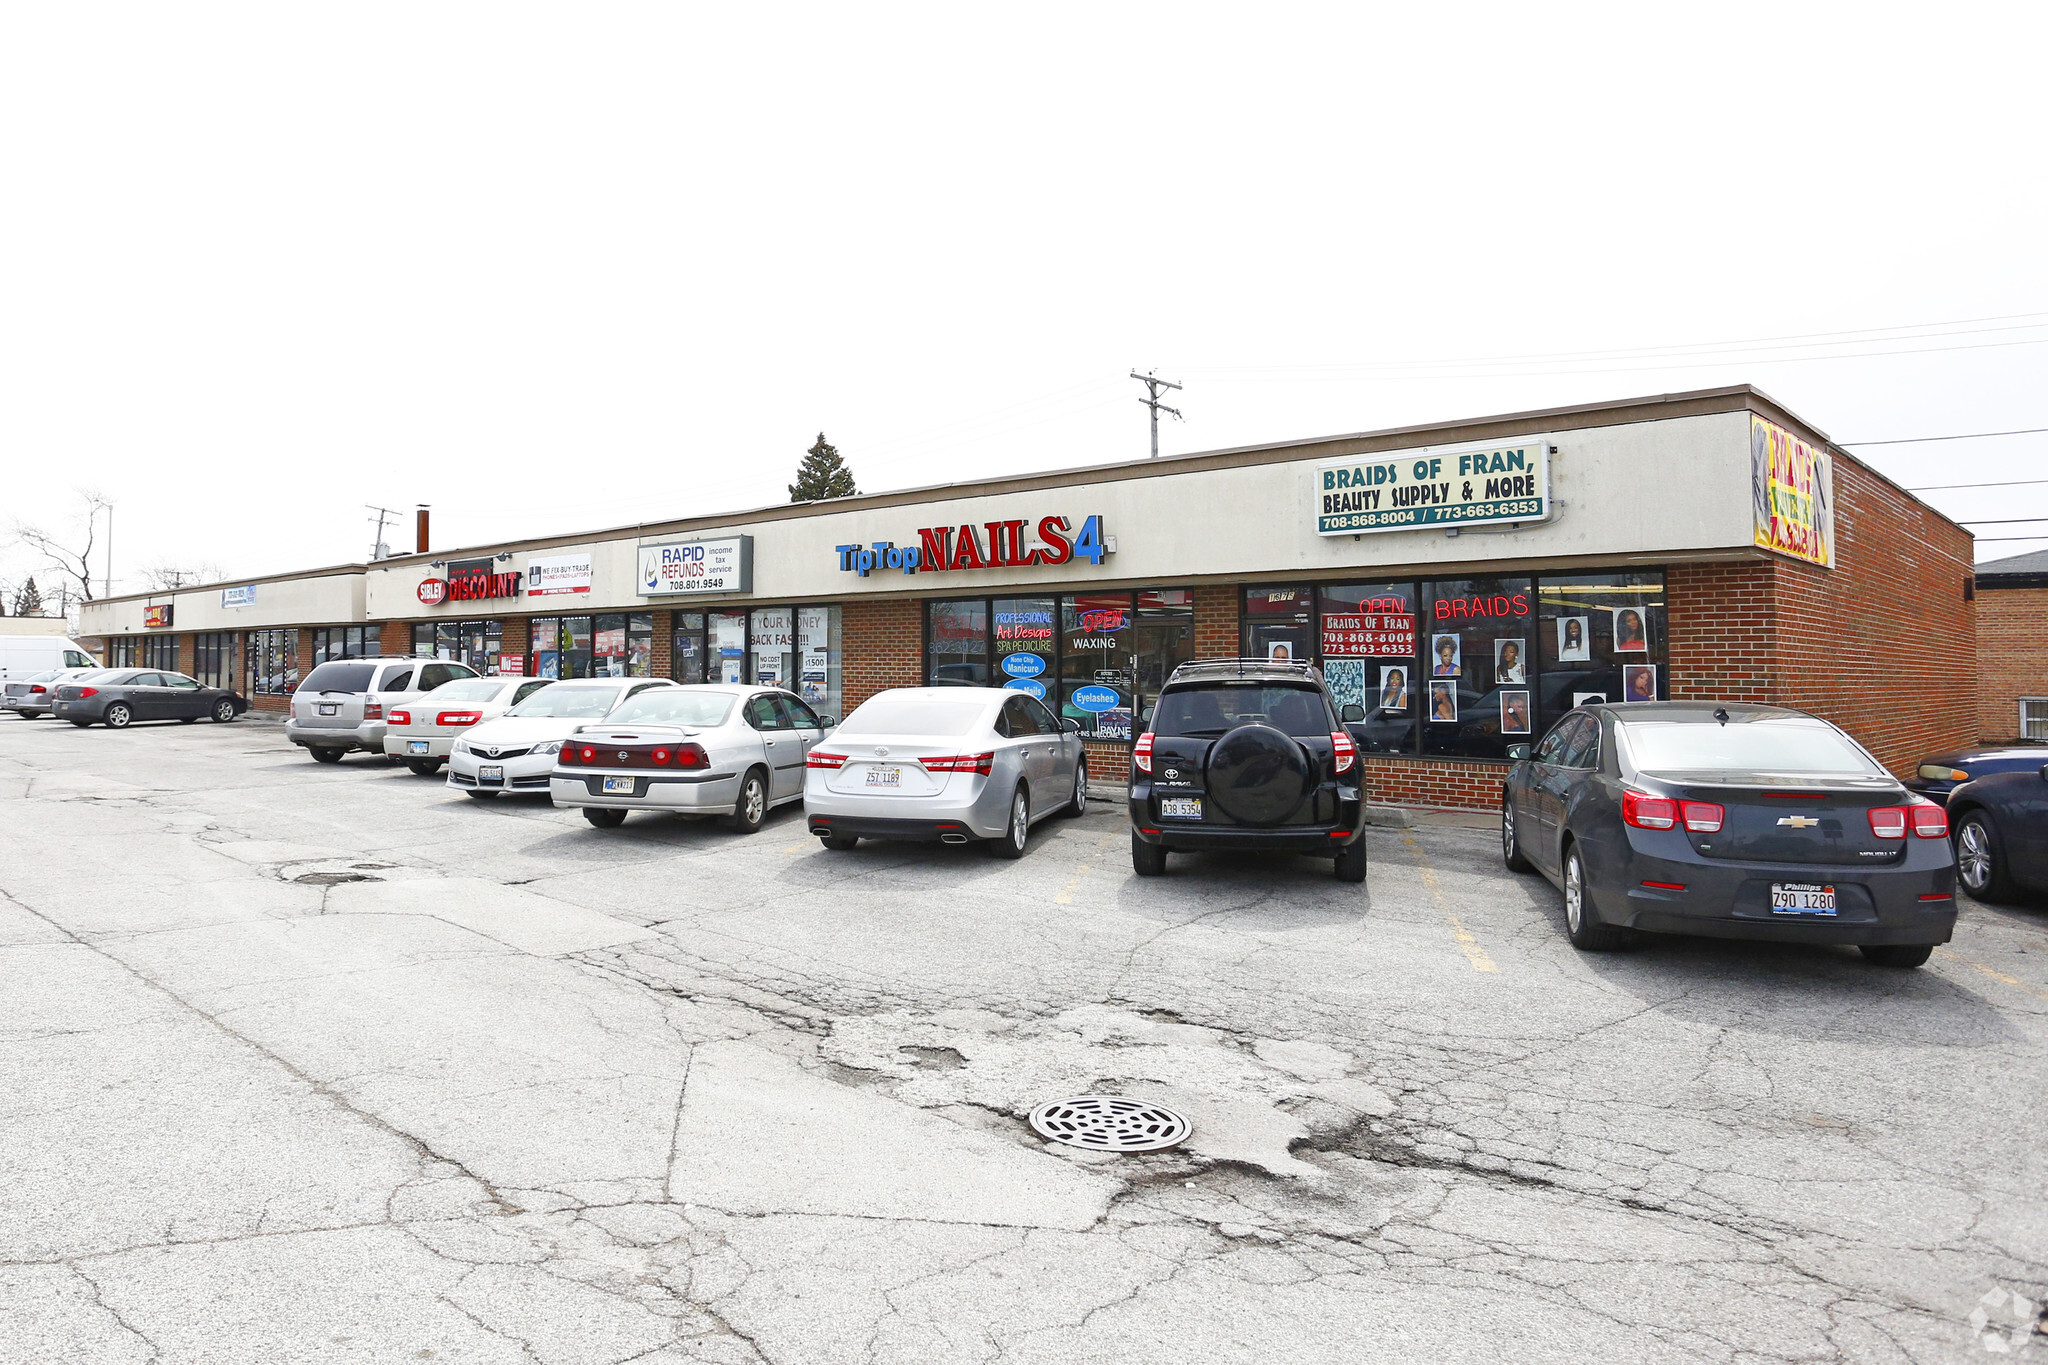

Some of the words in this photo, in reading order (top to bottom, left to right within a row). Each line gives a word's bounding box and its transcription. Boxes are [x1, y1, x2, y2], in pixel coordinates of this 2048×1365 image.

[1323, 463, 1397, 490] BRAIDS
[1413, 459, 1442, 480] OF
[1459, 450, 1534, 476] FRAN,
[1323, 490, 1380, 514] BEAUTY
[1392, 482, 1450, 507] SUPPLY
[1462, 480, 1473, 501] &
[1485, 474, 1535, 500] MORE
[1322, 510, 1416, 529] 708-868-8004
[1422, 509, 1428, 522] /
[1434, 500, 1538, 520] 773-663-6353
[708, 546, 732, 554] income
[918, 516, 1072, 572] NAILS
[1074, 515, 1108, 565] 4
[662, 546, 704, 564] RAPID
[662, 562, 704, 579] REFUNDS
[708, 566, 732, 574] service
[449, 572, 517, 601] DISCOUNT
[670, 578, 724, 590] 708.801.9549
[420, 582, 442, 600] SIBLEY
[1359, 598, 1404, 614] OPEN
[1434, 594, 1529, 620] BRAIDS
[758, 617, 784, 628] YOUR
[995, 612, 1052, 624] PROFESSIONAL
[1082, 609, 1123, 632] OPEN
[996, 624, 1013, 640] Art
[1014, 624, 1052, 640] Designs
[1323, 632, 1413, 644] 708-868-8004
[996, 640, 1011, 652] SPA
[1012, 640, 1052, 652] PEDICURE
[1073, 638, 1116, 649] WAXING
[1324, 644, 1414, 654] 773-663-6353
[1023, 656, 1034, 664] Chip
[1007, 663, 1040, 673] Manicure
[1076, 692, 1115, 705] Eyelashes
[1100, 726, 1132, 738] PAYNE
[1784, 884, 1822, 892] Phillips
[1773, 892, 1797, 908] Z90
[1804, 894, 1835, 910] 1280
